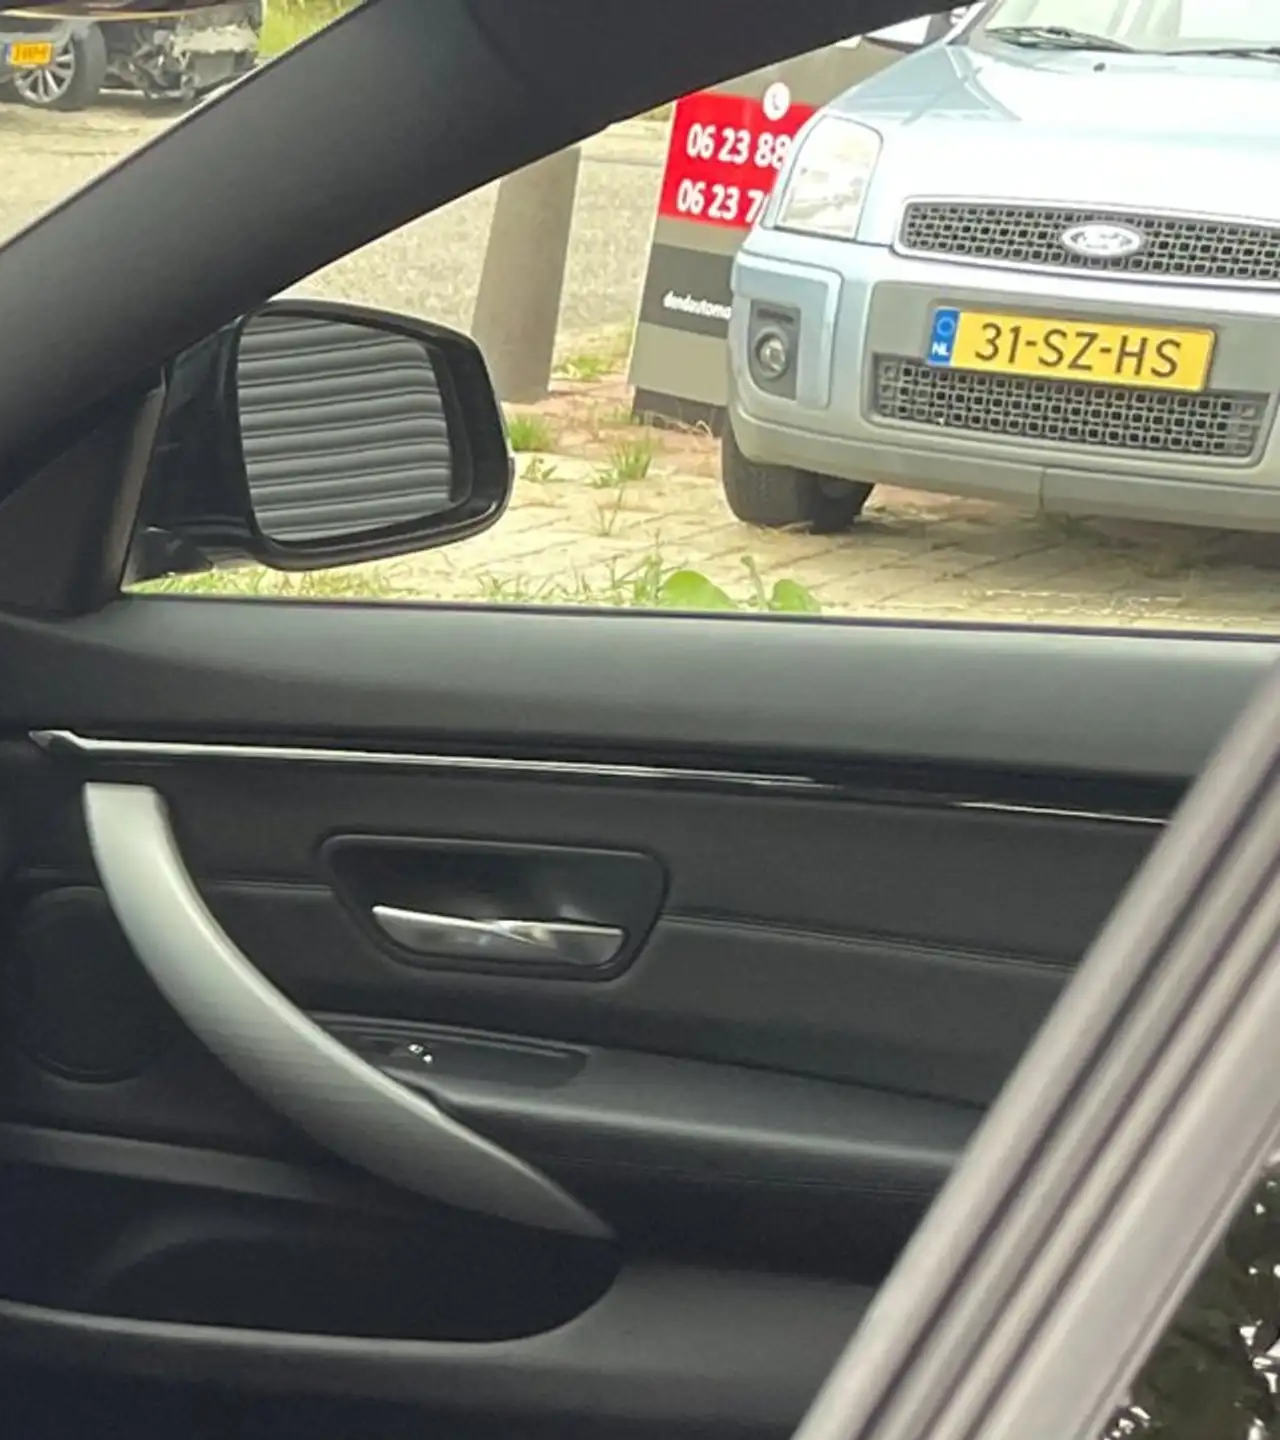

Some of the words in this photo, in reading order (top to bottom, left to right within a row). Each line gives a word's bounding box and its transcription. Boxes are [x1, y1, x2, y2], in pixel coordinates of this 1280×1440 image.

[686, 122, 716, 160] 06
[717, 127, 751, 166] 23
[676, 178, 707, 216] 06
[708, 183, 740, 220] 23
[974, 322, 1182, 379] 31-SZ-HS
